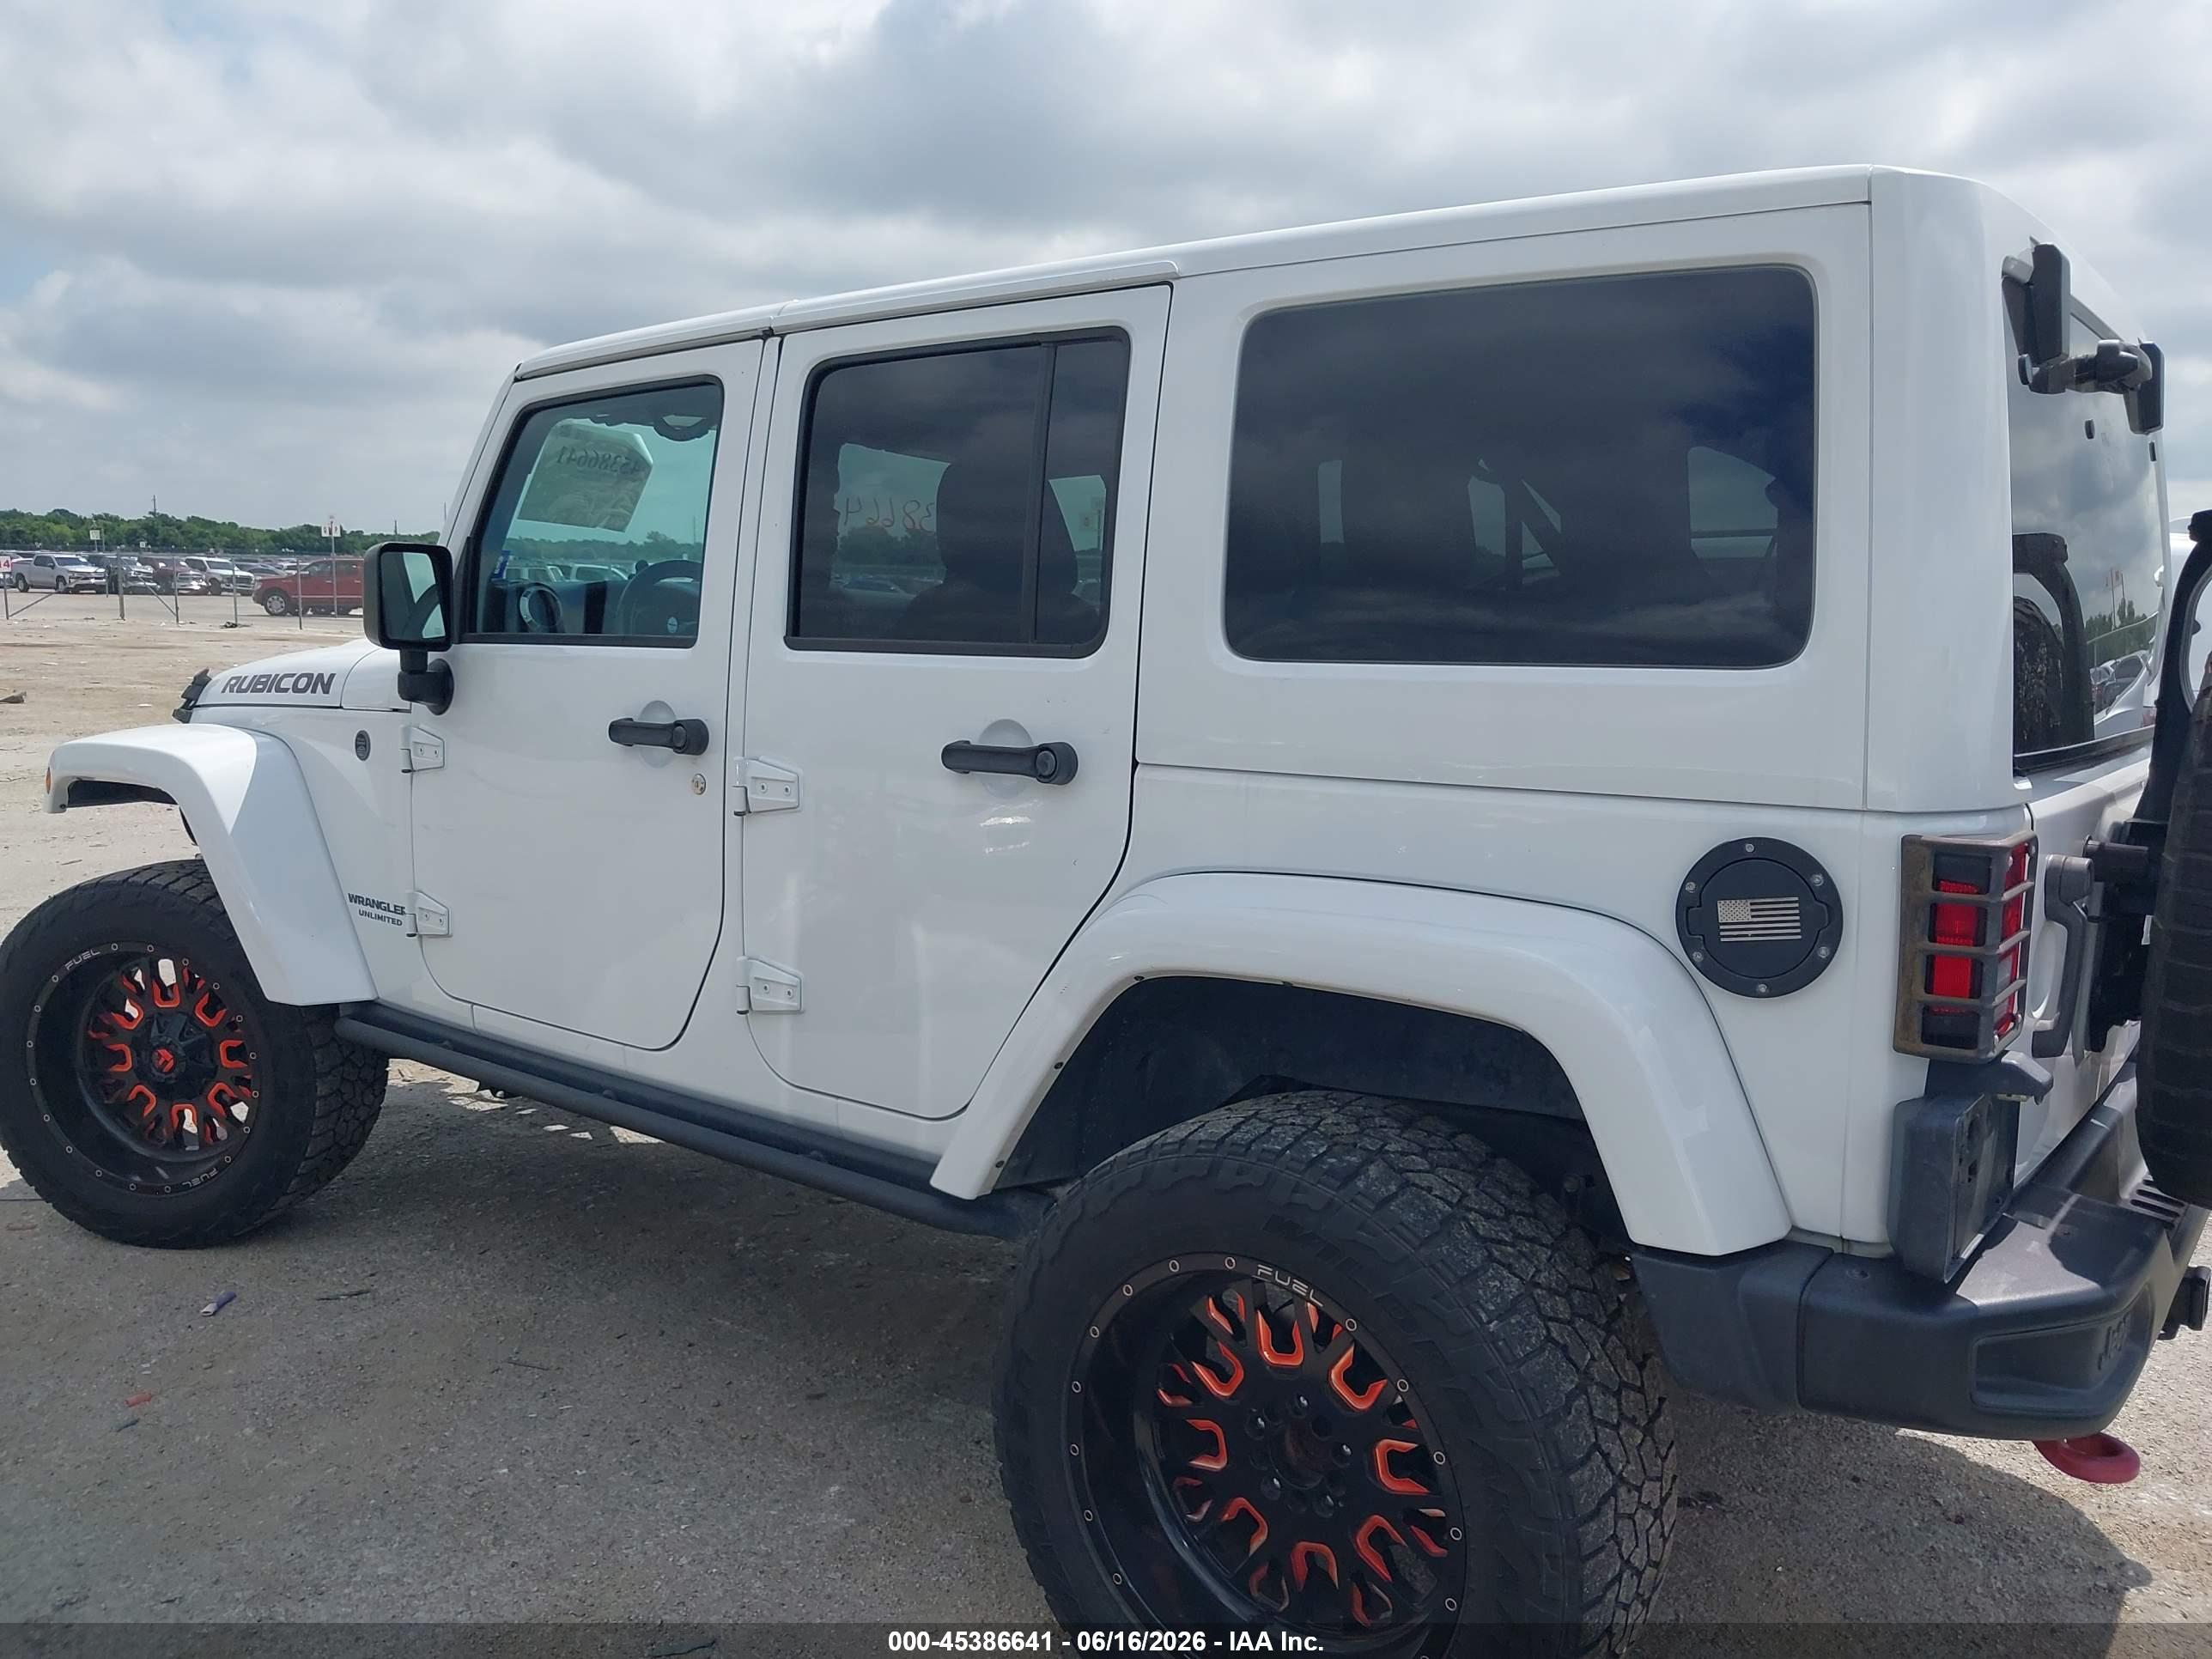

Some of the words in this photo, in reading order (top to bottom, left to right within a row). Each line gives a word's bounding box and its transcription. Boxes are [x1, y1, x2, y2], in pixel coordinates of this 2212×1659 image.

[221, 672, 337, 695] RUBICON
[358, 908, 403, 927] UNLIMITED
[64, 949, 101, 970] FUEL
[181, 1167, 219, 1188] FUEL
[1257, 1264, 1324, 1307] FUEL
